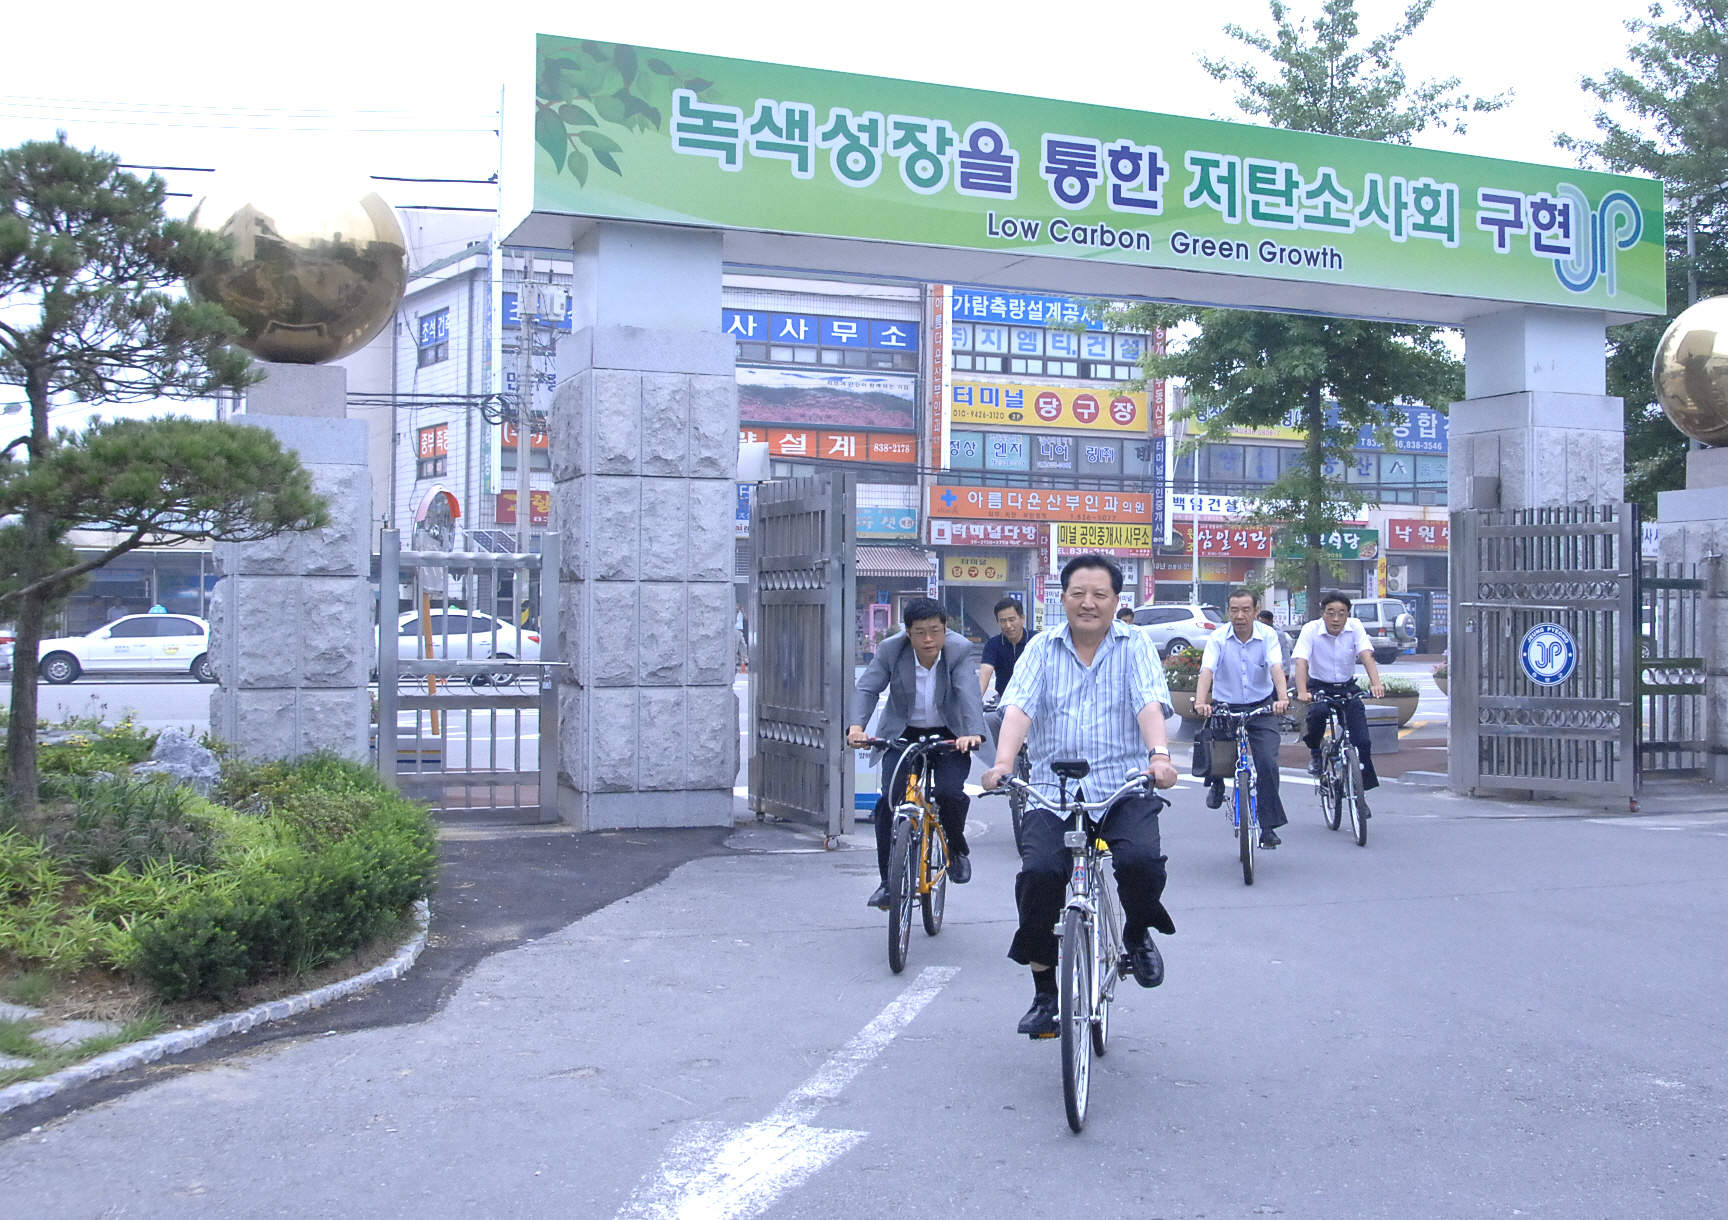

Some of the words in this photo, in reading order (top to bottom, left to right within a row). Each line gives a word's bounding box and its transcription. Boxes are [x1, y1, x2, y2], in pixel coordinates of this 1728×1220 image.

[672, 90, 1018, 199] 녹색성장을
[1042, 135, 1166, 214] 통한
[1185, 152, 1459, 245] 저탄소사회
[1478, 189, 1575, 256] 구현
[988, 212, 1040, 242] Low
[1049, 217, 1151, 252] Carbon
[1171, 231, 1249, 263] Green
[1259, 240, 1344, 272] Growth
[422, 318, 436, 343] 초석
[953, 386, 1024, 410] 터미널
[1037, 393, 1135, 424] 당구장
[422, 432, 435, 455] 중부
[874, 443, 910, 454] 838-2178
[952, 523, 1037, 540] 터미널다방
[1058, 525, 1077, 545] 미널
[1080, 525, 1122, 546] 공인중개사
[1124, 527, 1150, 546] 사무소
[1198, 529, 1267, 550] 삼일식당
